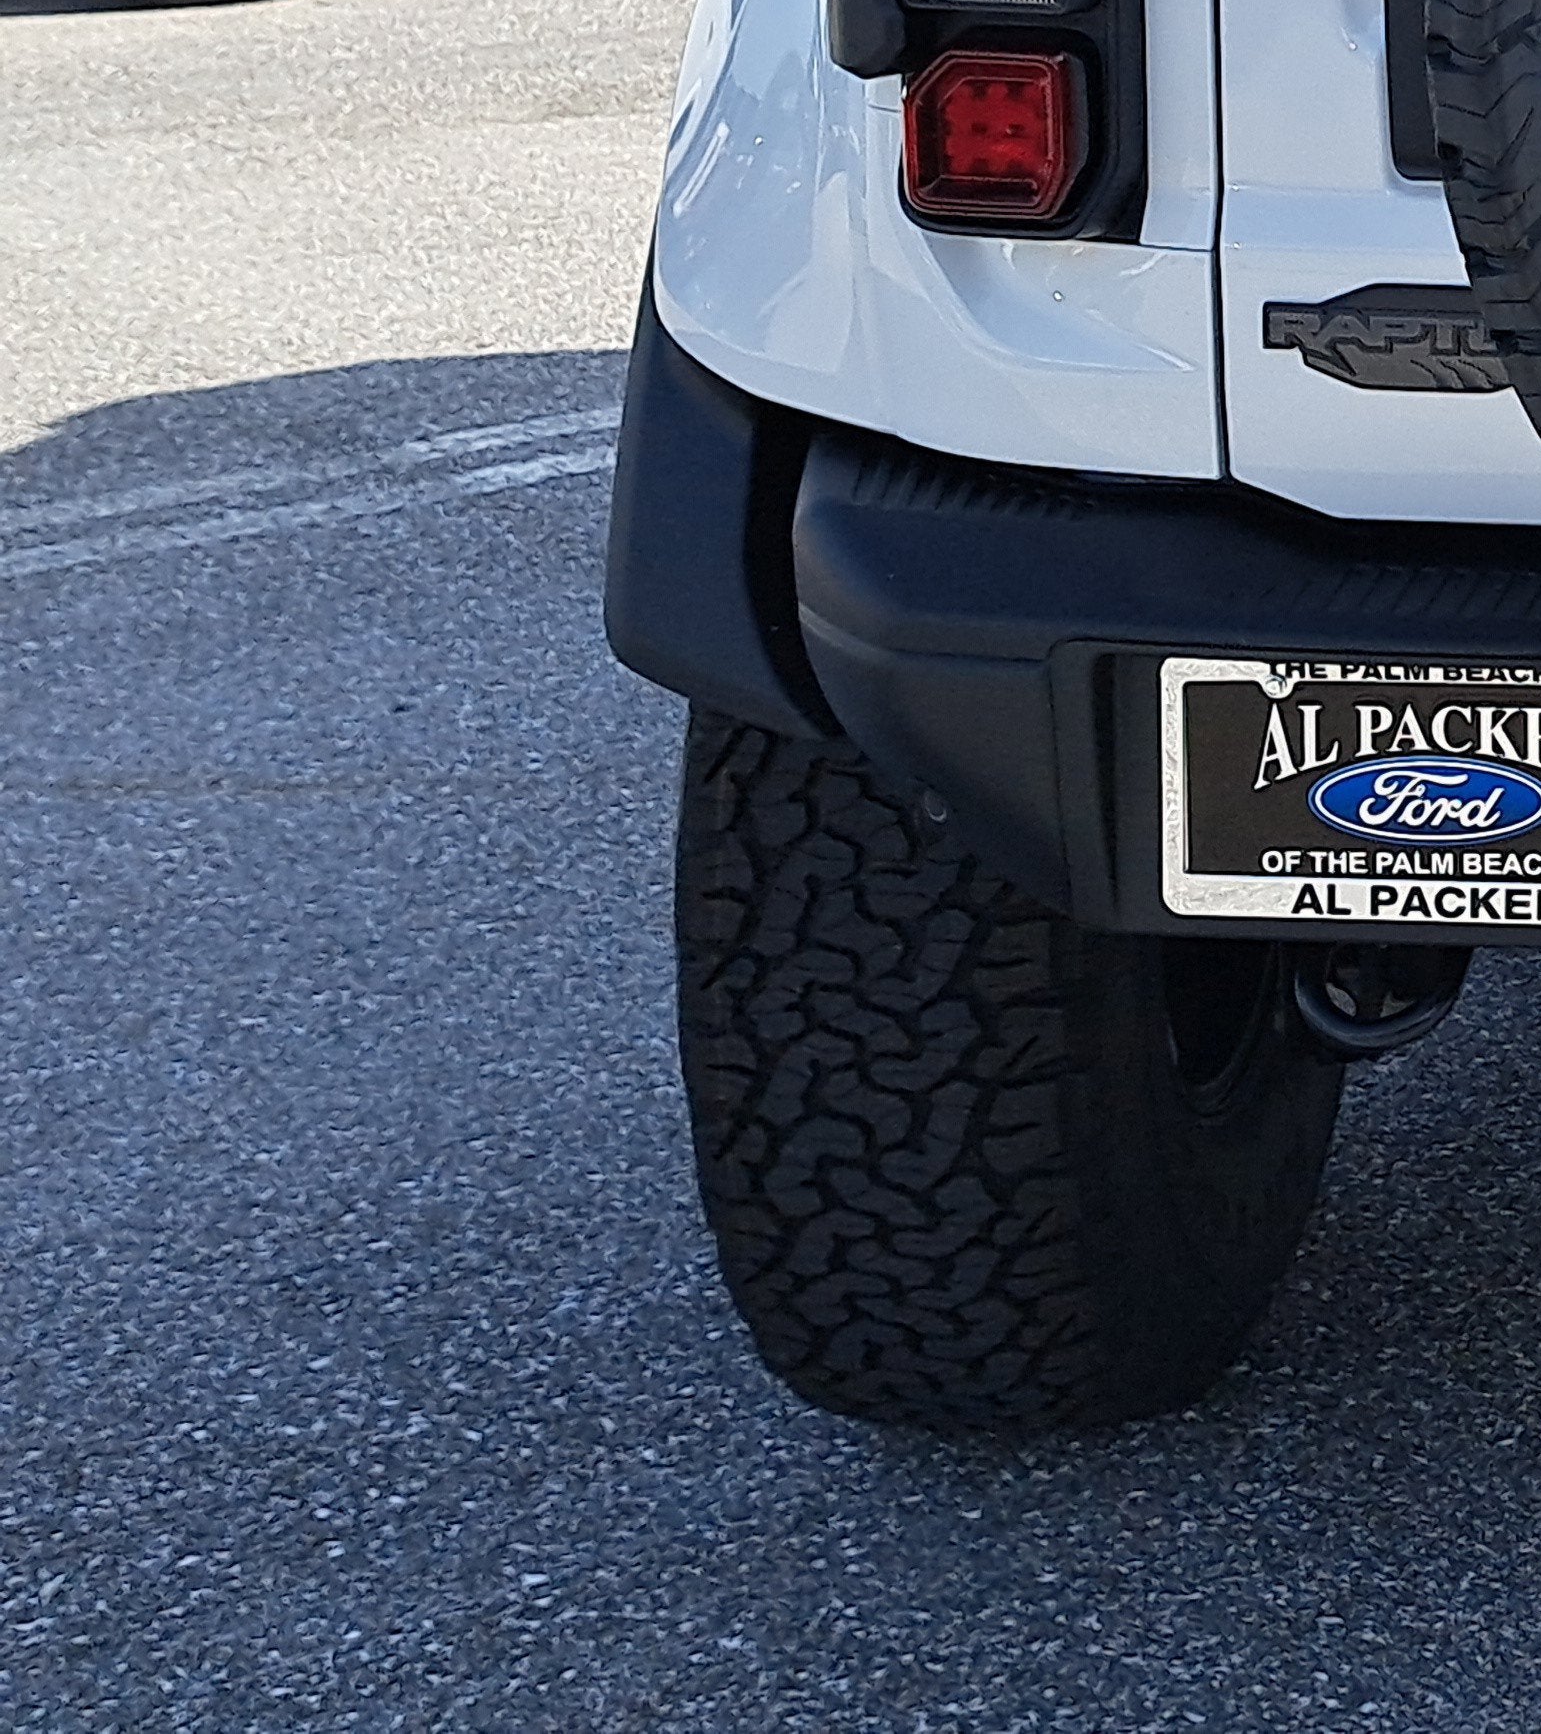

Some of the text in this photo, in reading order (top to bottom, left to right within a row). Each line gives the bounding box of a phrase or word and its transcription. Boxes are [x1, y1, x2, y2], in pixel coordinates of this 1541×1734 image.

[1340, 663, 1432, 681] PALM
[1253, 704, 1339, 791] AL
[1358, 770, 1505, 829] Ford
[1261, 850, 1302, 874] OF
[1307, 851, 1369, 875] THE
[1375, 851, 1454, 876] PALM
[1290, 882, 1352, 916] AL
